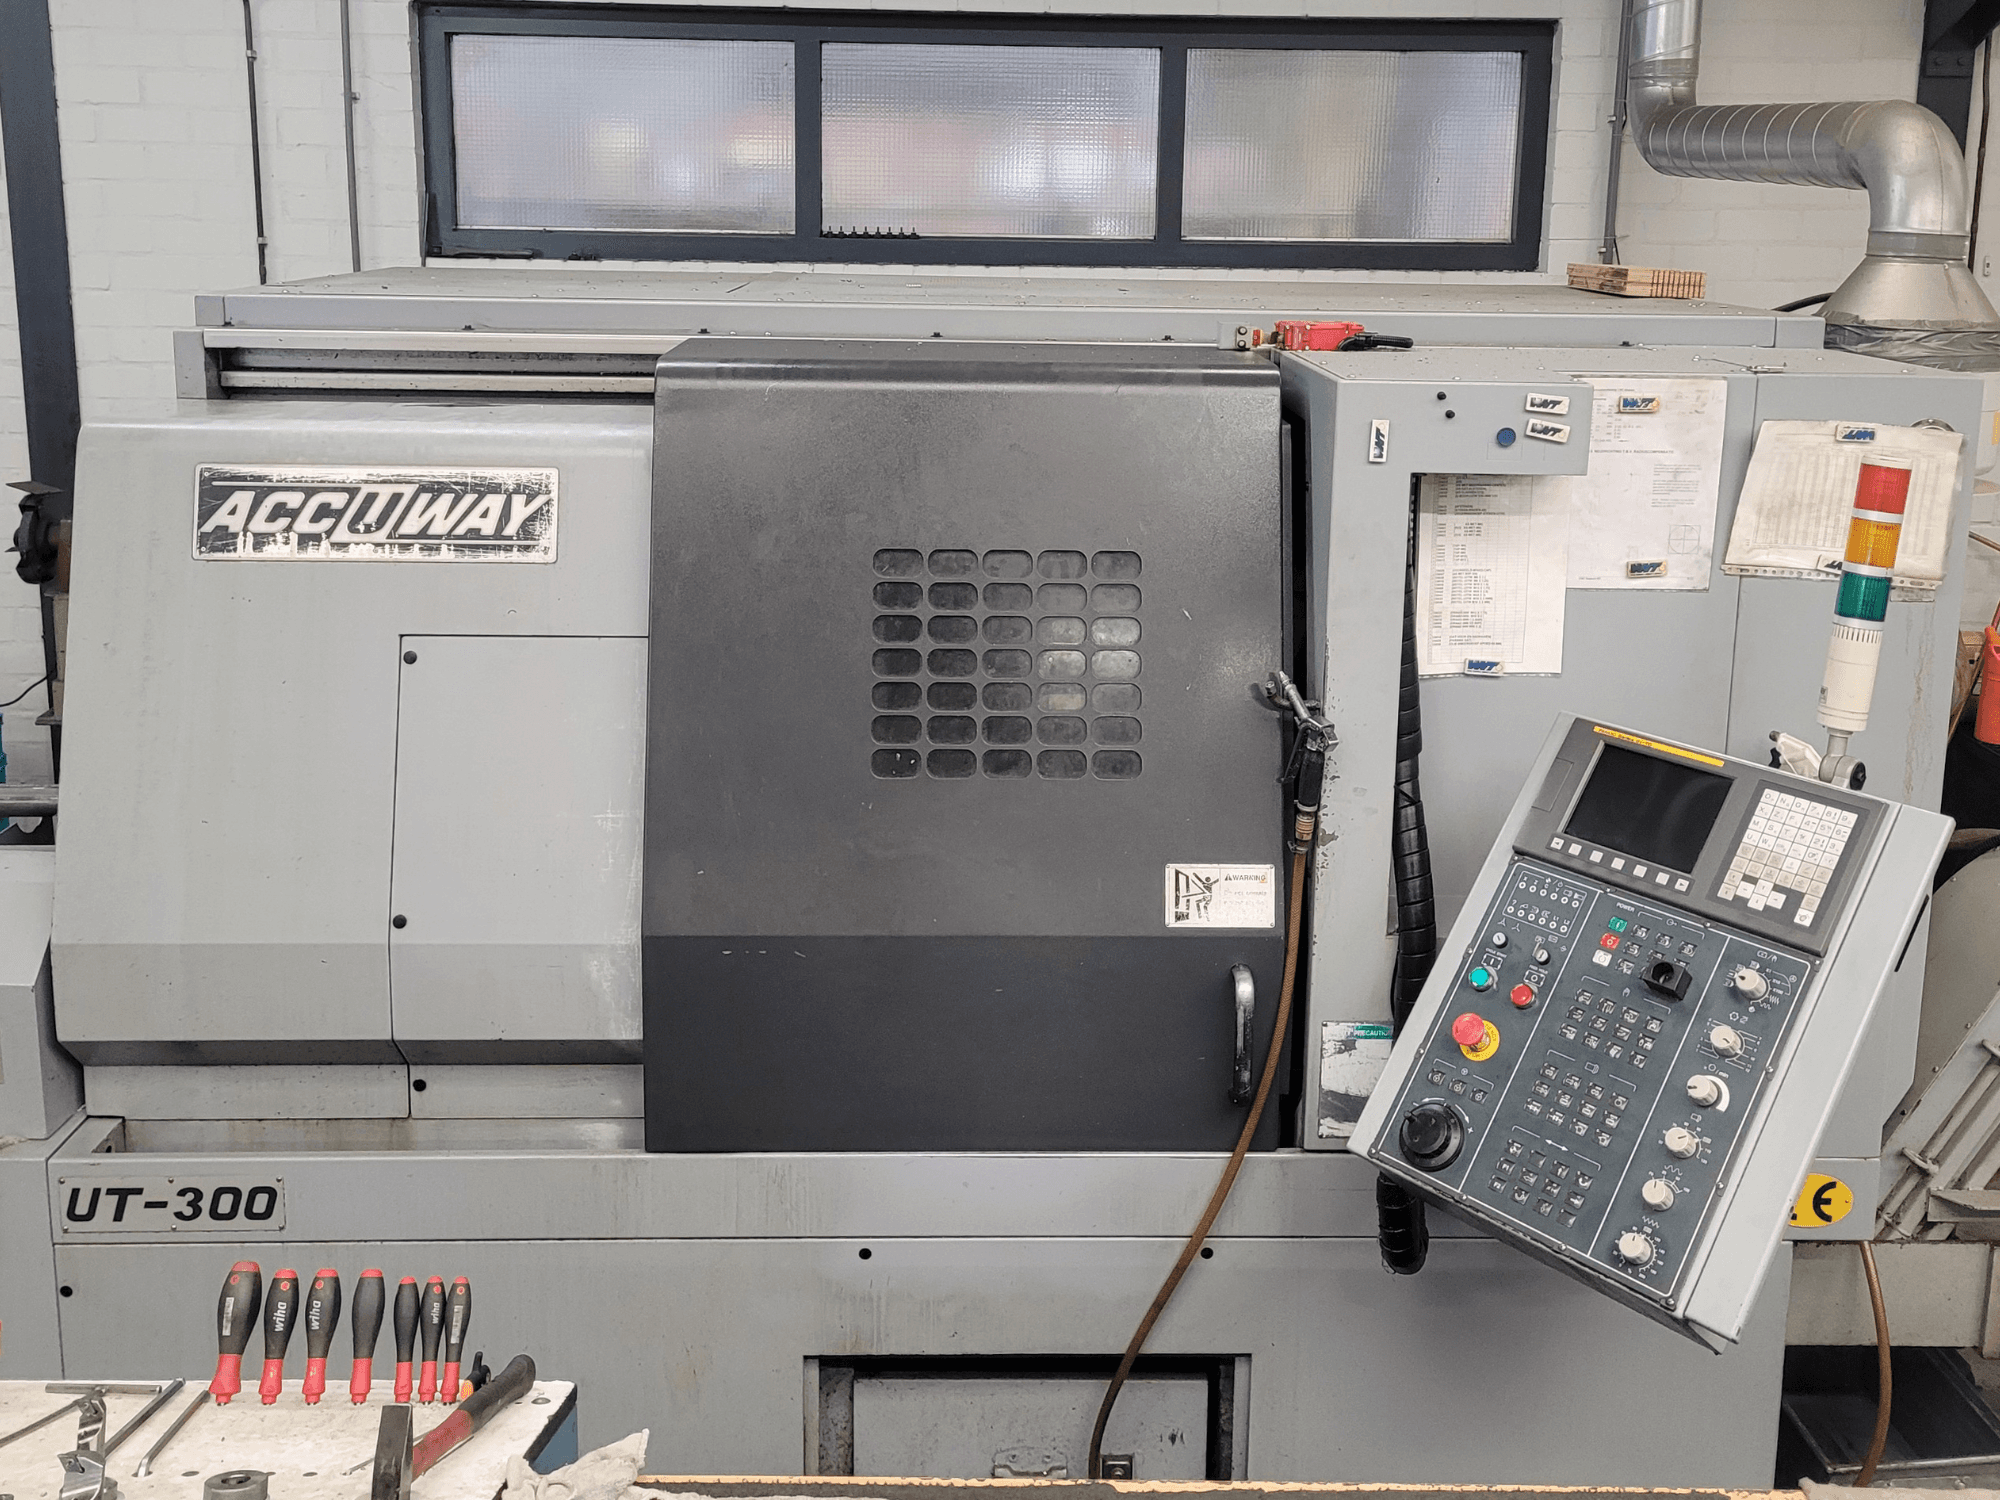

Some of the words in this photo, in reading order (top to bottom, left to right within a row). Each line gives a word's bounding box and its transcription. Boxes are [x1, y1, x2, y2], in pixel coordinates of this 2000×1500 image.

[199, 484, 553, 543] ACCUWAY
[1616, 902, 1635, 912] POWER
[66, 1186, 278, 1222] UT-300
[272, 1302, 287, 1332] wiha
[309, 1300, 322, 1330] wiha
[431, 1302, 440, 1324] wiha
